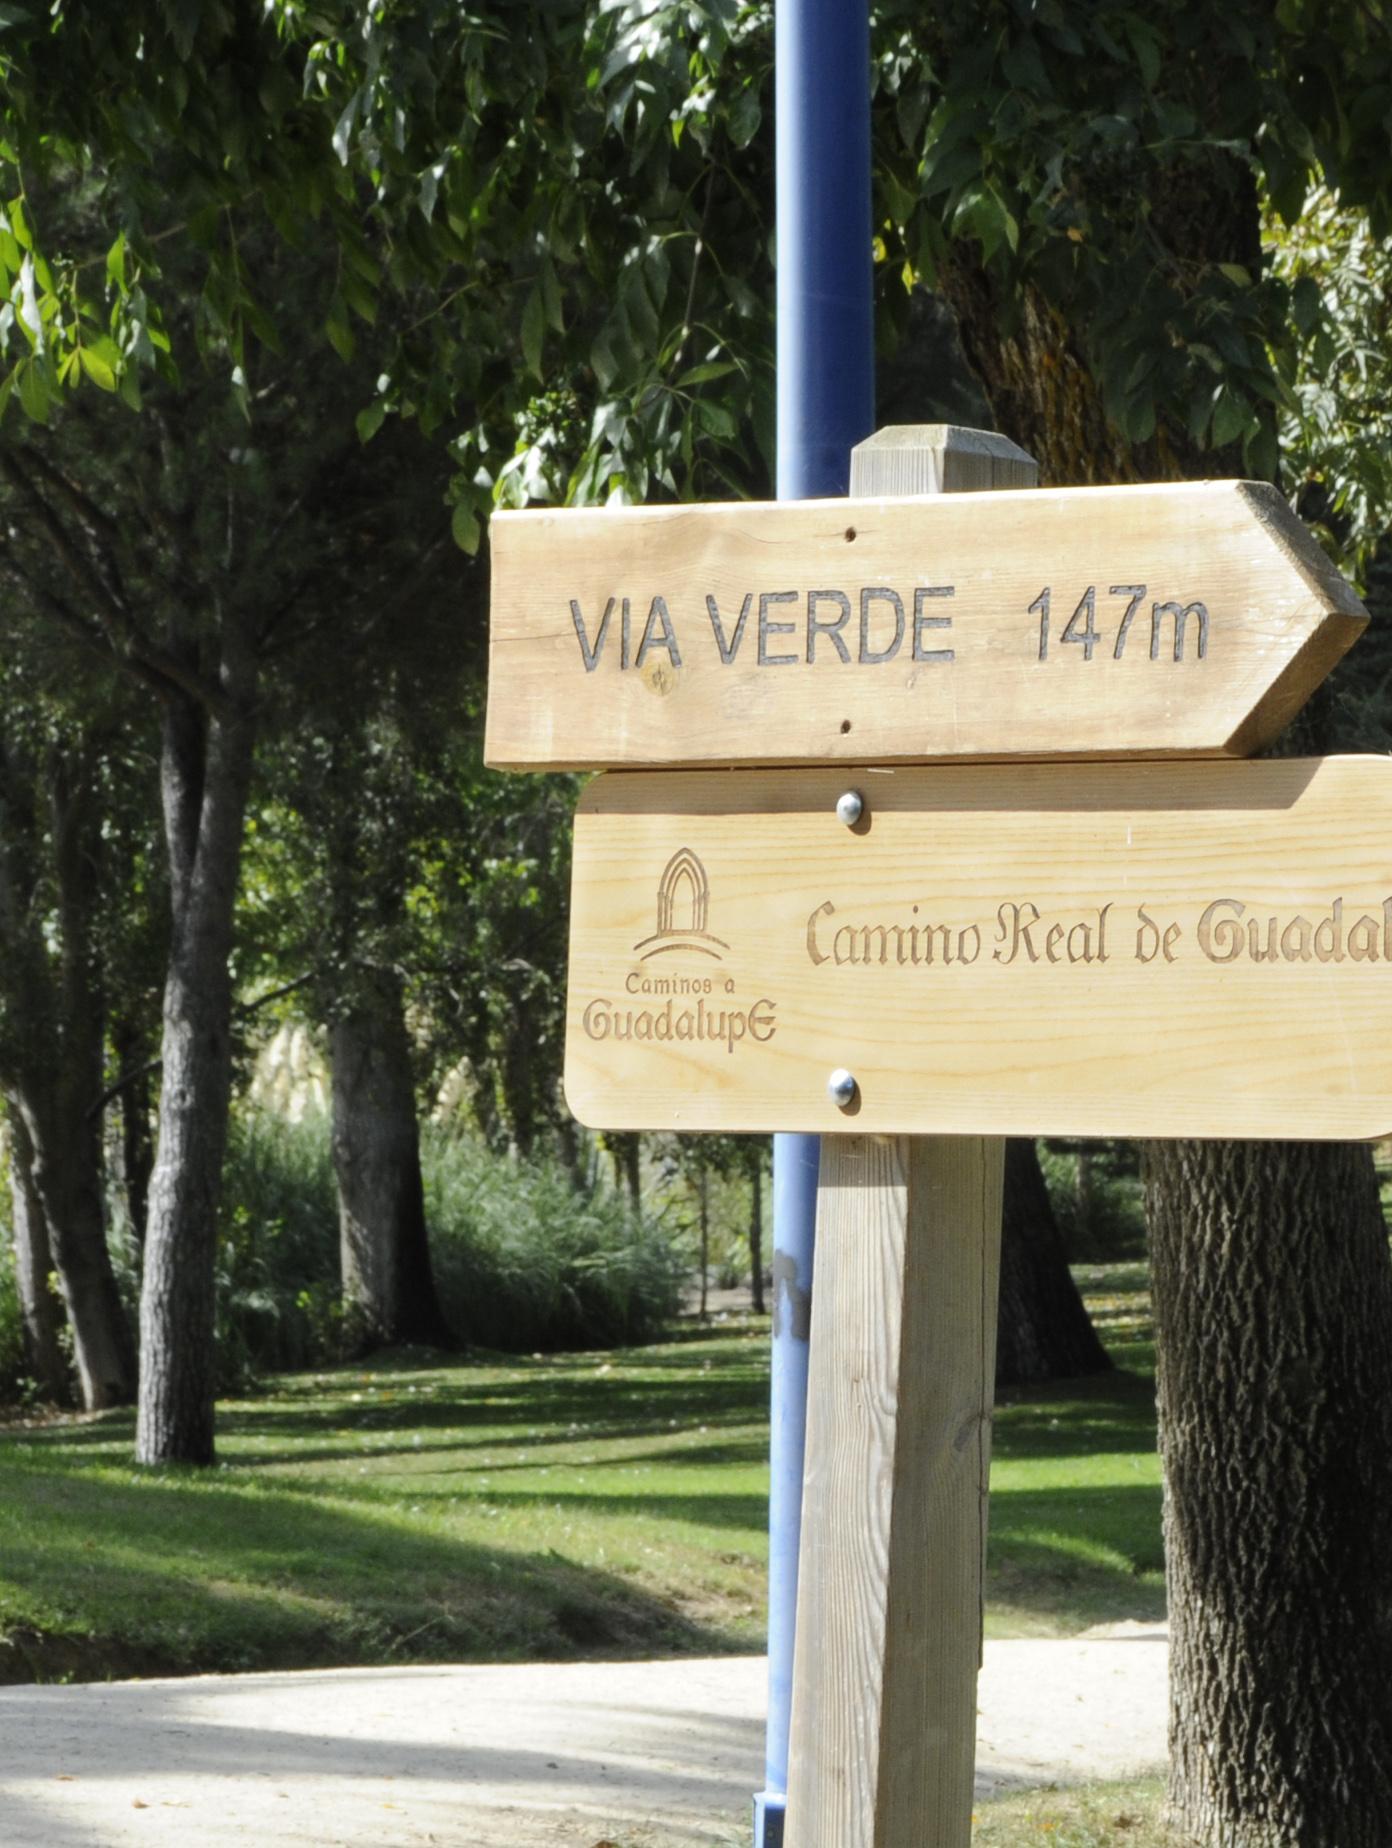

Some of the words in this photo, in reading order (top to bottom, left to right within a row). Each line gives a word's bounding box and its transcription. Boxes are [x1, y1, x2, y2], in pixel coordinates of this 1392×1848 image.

[569, 596, 683, 672] VIA
[705, 586, 956, 666] VERDE
[1027, 584, 1209, 662] 147m
[806, 900, 980, 966] Camino
[993, 902, 1110, 966] Real
[1133, 902, 1183, 964] de
[624, 971, 713, 995] Caminos
[724, 977, 736, 994] a
